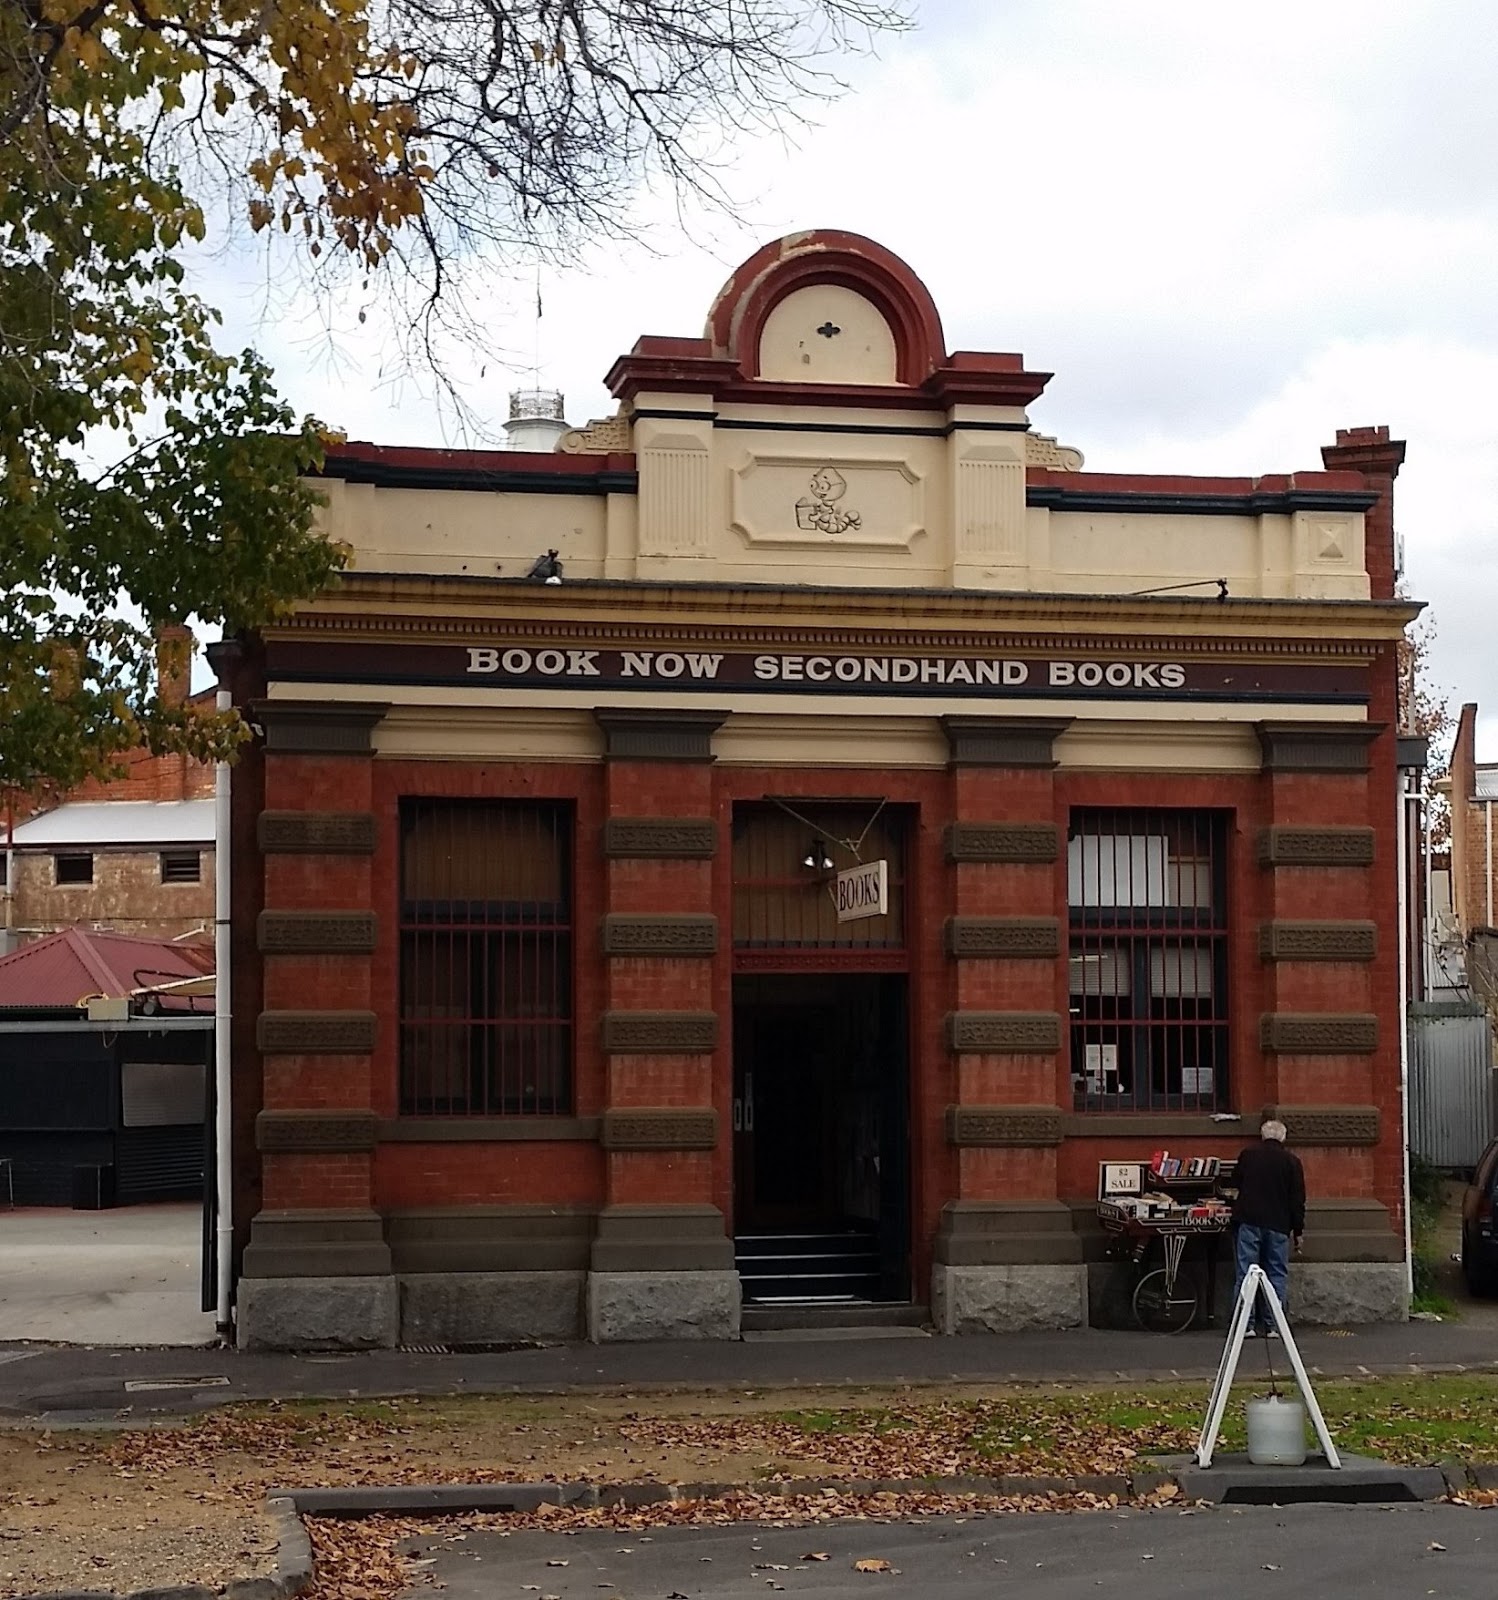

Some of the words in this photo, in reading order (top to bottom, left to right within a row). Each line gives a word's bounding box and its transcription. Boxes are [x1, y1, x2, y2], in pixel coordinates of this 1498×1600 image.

[466, 647, 600, 676] BOOK
[620, 652, 724, 679] NOW
[753, 655, 1029, 685] SECONDHAND
[1048, 661, 1186, 688] BOOKS
[839, 872, 880, 911] BOOKS
[1118, 1168, 1128, 1176] $2
[1111, 1179, 1136, 1189] SALE
[1184, 1216, 1212, 1226] BOOK
